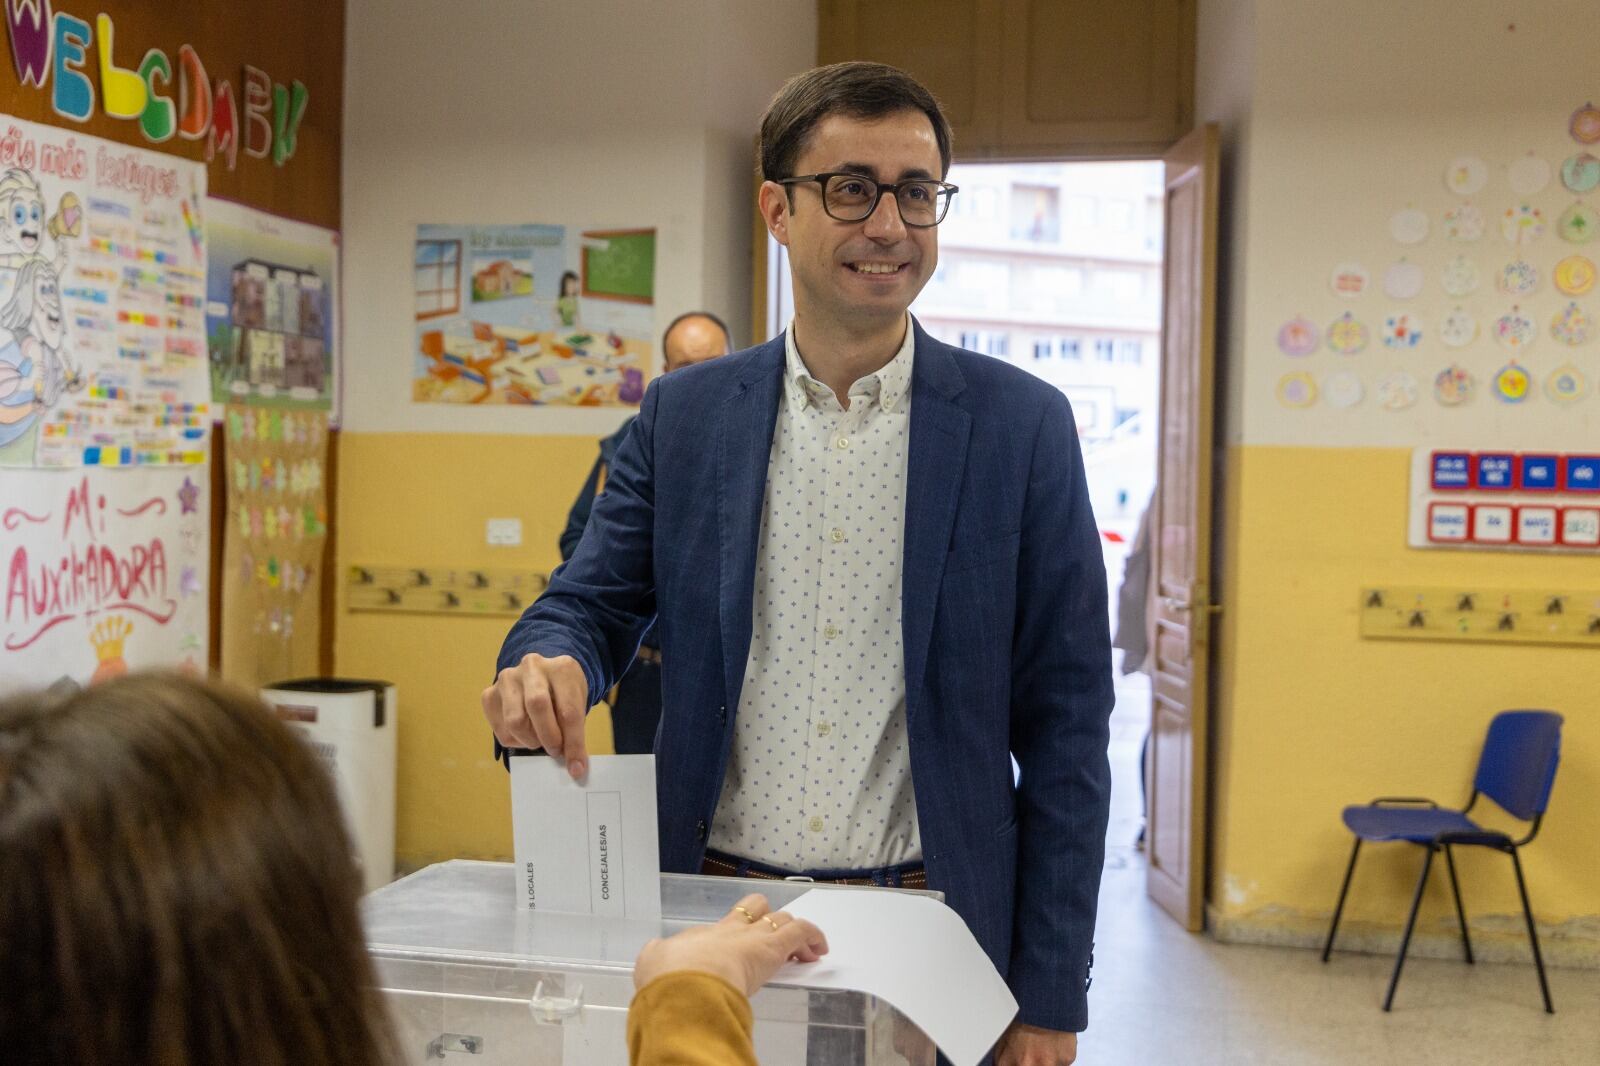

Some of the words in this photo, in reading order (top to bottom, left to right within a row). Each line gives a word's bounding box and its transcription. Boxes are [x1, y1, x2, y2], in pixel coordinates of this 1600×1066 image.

[63, 476, 106, 541] Mi
[526, 862, 535, 901] LOCALES
[599, 824, 610, 900] CONCEJALES/AS
